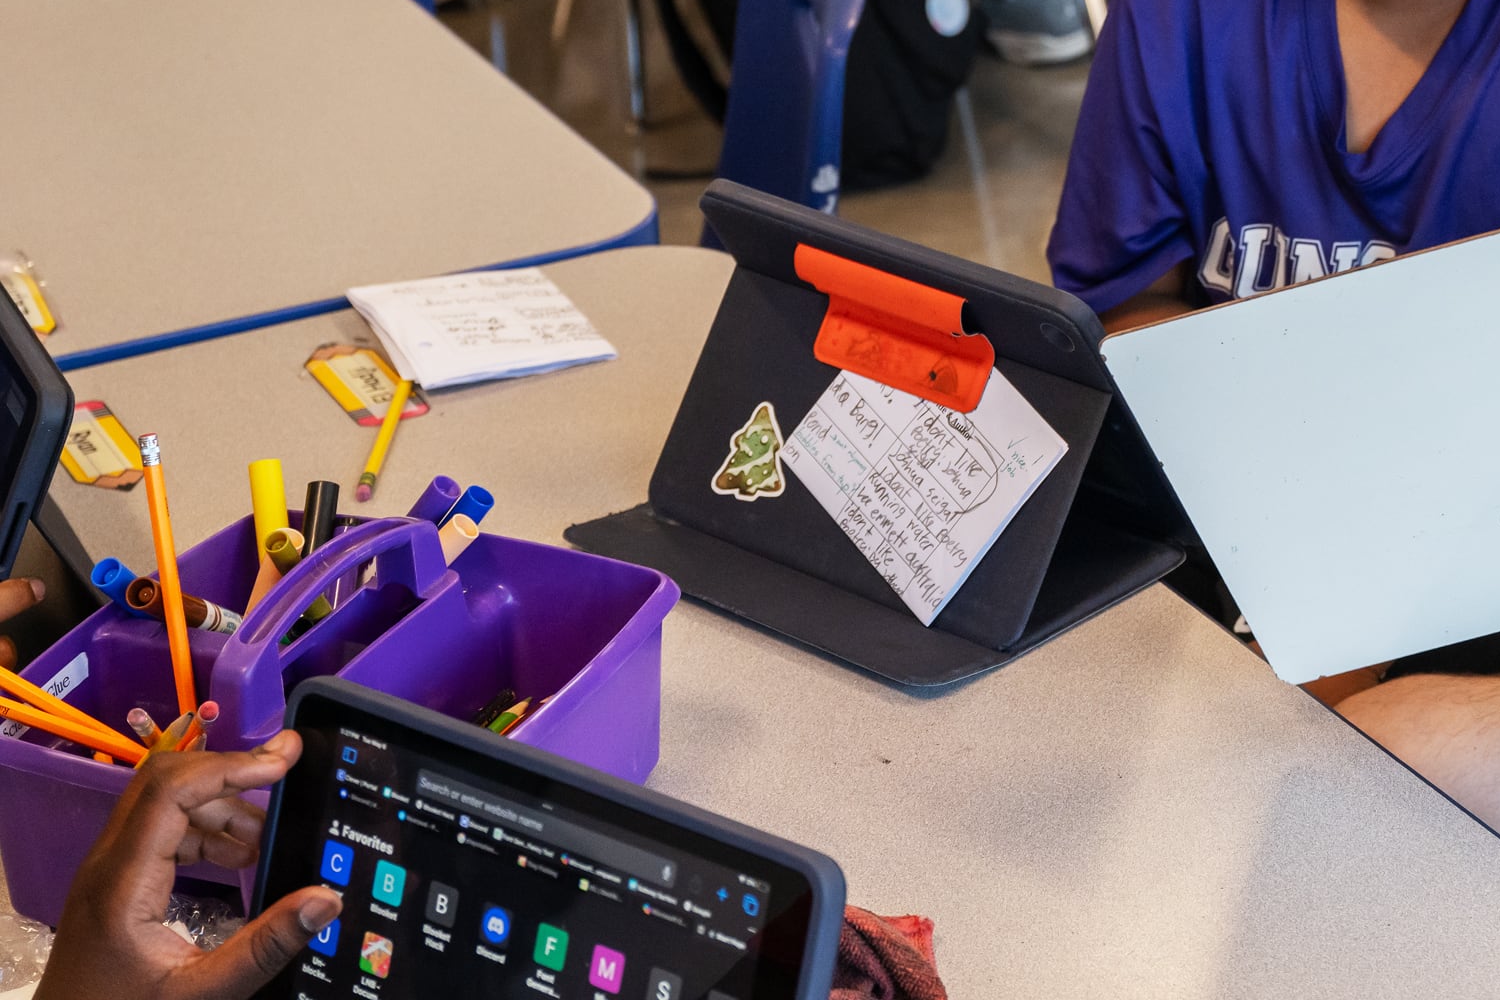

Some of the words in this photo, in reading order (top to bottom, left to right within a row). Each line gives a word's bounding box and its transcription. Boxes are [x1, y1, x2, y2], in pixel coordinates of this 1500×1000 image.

[420, 776, 450, 798] Search
[460, 793, 483, 809] enter
[484, 803, 518, 823] website
[518, 815, 544, 833] name
[341, 824, 394, 856] Favorites
[330, 853, 344, 873] C
[383, 873, 395, 893] B
[435, 893, 448, 914] B
[544, 936, 558, 957] F
[598, 957, 616, 981] M
[656, 980, 671, 1000] S
